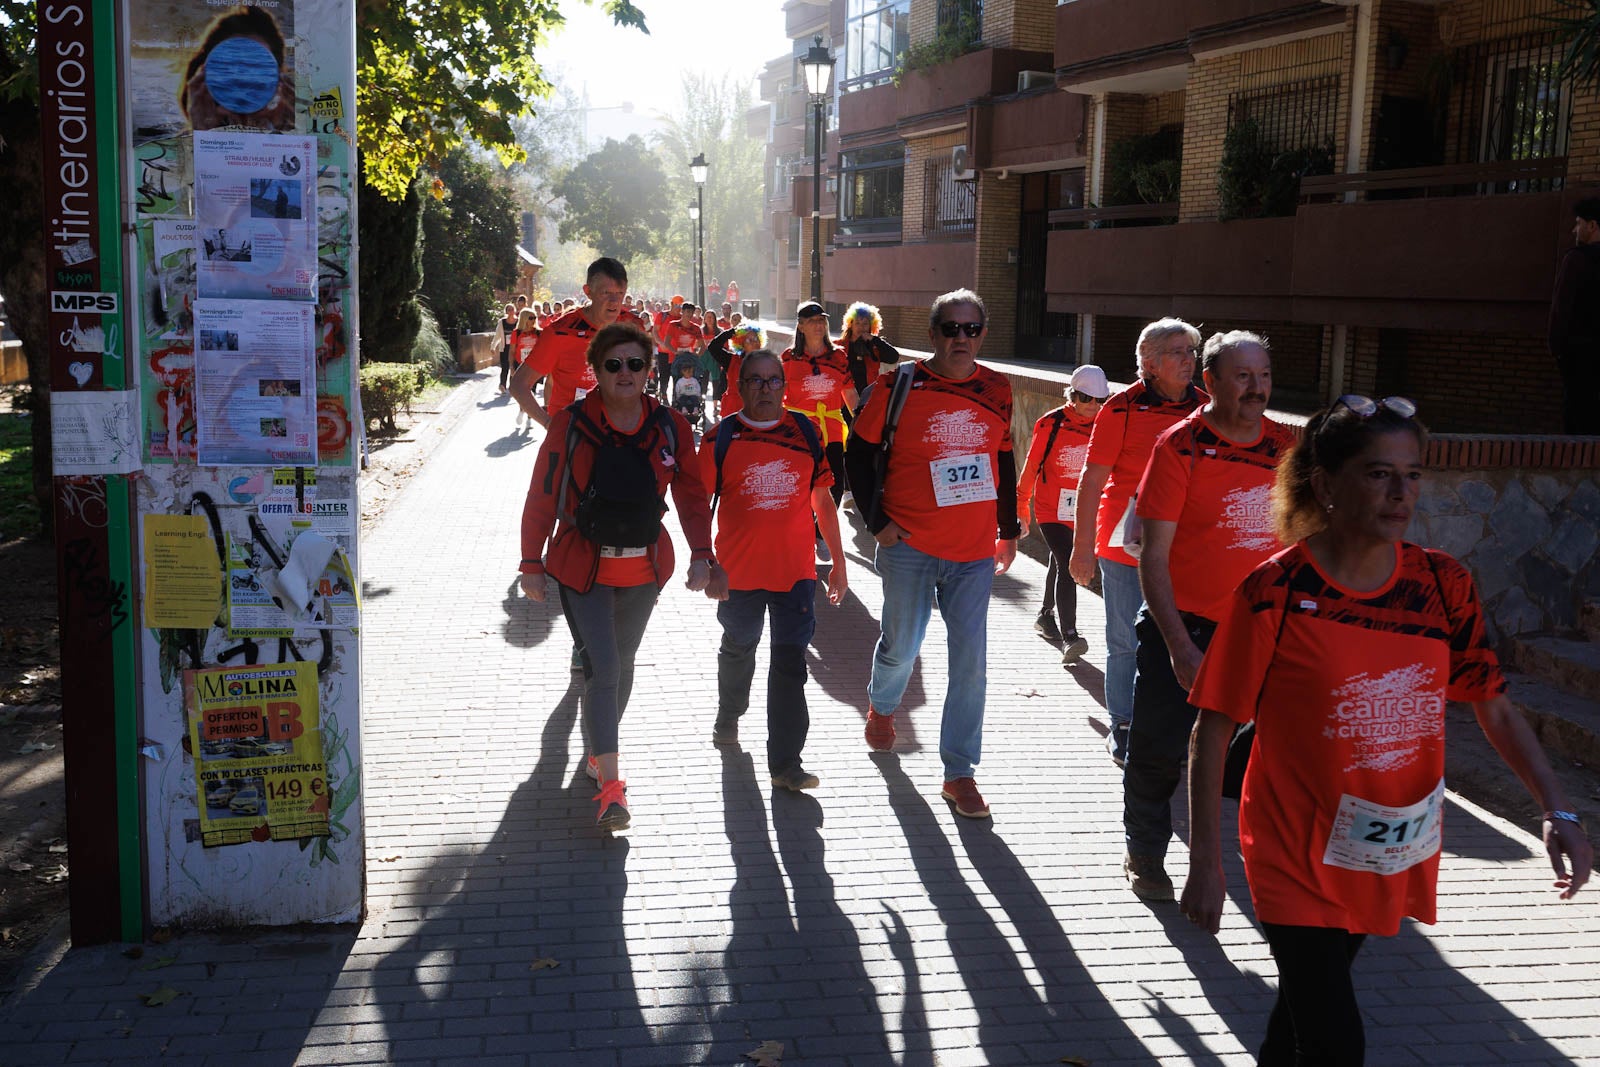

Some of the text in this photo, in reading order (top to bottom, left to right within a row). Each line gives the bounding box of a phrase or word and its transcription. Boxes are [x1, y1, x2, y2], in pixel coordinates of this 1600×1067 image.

[326, 101, 339, 109] NO
[200, 139, 228, 147] Domingo
[54, 294, 116, 311] MPS
[929, 422, 985, 437] carrera
[947, 464, 980, 483] 372
[744, 474, 796, 487] carrera
[262, 504, 293, 514] OFERTA
[155, 530, 187, 538] Learning
[231, 629, 284, 637] Mejoramos
[225, 669, 297, 681] AUTOESCUELAS
[203, 674, 297, 699] MOLINA
[204, 691, 298, 704] TODOS LOS PERMISOS
[1336, 695, 1441, 720] carrera
[208, 701, 305, 742] OFERTON B
[209, 723, 258, 736] PERMISO
[1355, 744, 1369, 754] 19
[1372, 741, 1395, 752] NOV
[200, 762, 322, 780] CON 10 CLASES PRÁCTICAS
[266, 777, 325, 801] 149 €
